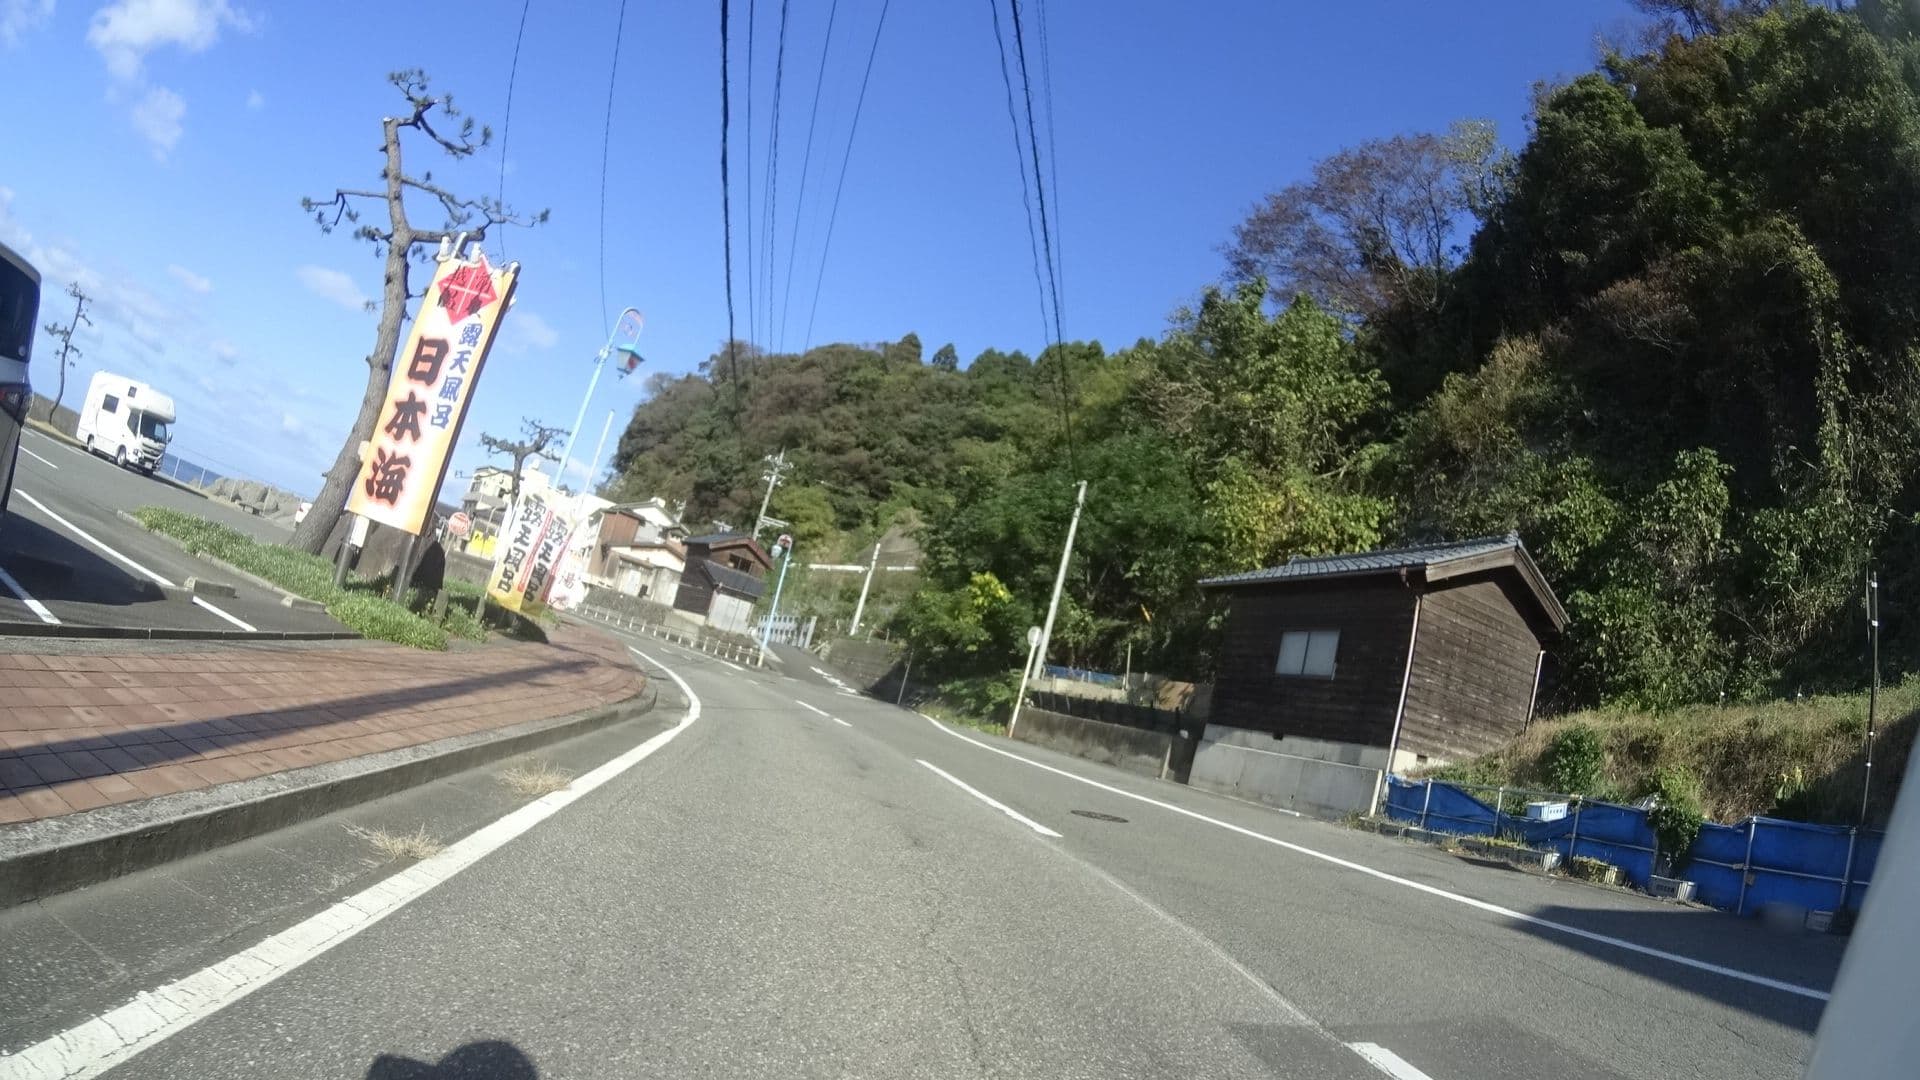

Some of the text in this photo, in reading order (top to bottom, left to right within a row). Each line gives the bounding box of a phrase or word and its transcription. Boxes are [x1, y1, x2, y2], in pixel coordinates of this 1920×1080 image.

[365, 334, 450, 506] 日本海
[430, 322, 483, 430] 露天風呂
